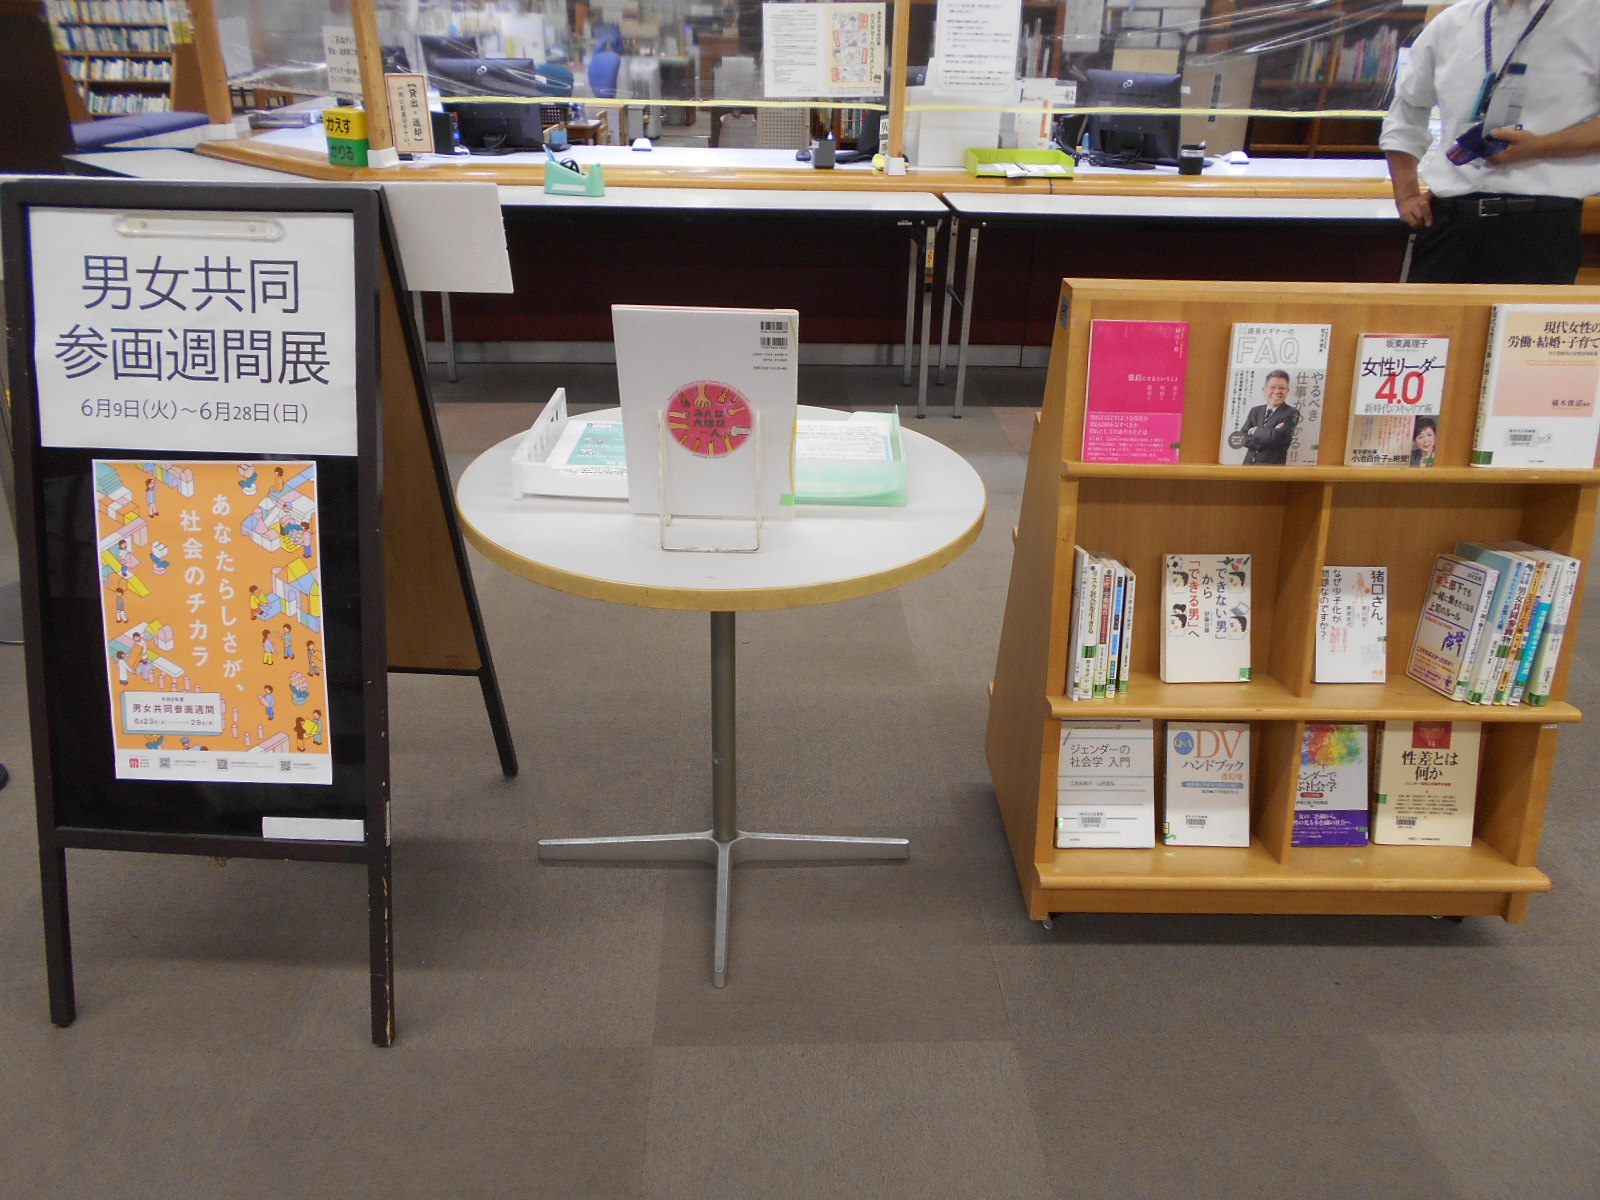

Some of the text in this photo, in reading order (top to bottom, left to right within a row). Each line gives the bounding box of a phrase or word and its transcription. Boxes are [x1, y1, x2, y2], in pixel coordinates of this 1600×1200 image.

[326, 116, 351, 134] かえす
[330, 145, 355, 161] かりる
[81, 254, 300, 315] 男女共同
[1544, 320, 1600, 333] 現代女性の
[54, 323, 331, 386] 参画週間展
[1236, 336, 1300, 365] FAQ
[1361, 355, 1446, 378] 女性リーダー
[1308, 371, 1325, 423] やるべき
[1375, 371, 1425, 405] 4.0
[179, 509, 209, 668] 社会のチカラ
[211, 493, 245, 692] あなたらしさが、
[1187, 560, 1201, 638] 「できる男」へ
[1202, 573, 1214, 600] から
[1331, 569, 1343, 624] なぜ少子化が
[1370, 569, 1386, 626] 猪口さん、
[132, 703, 215, 715] 男女共同参画週間
[1069, 743, 1132, 756] ジェンダーの
[1194, 728, 1245, 759] DV
[1069, 756, 1132, 769] 社会学 入門
[1182, 759, 1245, 772] ハンドブック
[1401, 750, 1459, 766] 性差とは
[1415, 765, 1443, 782] 何か
